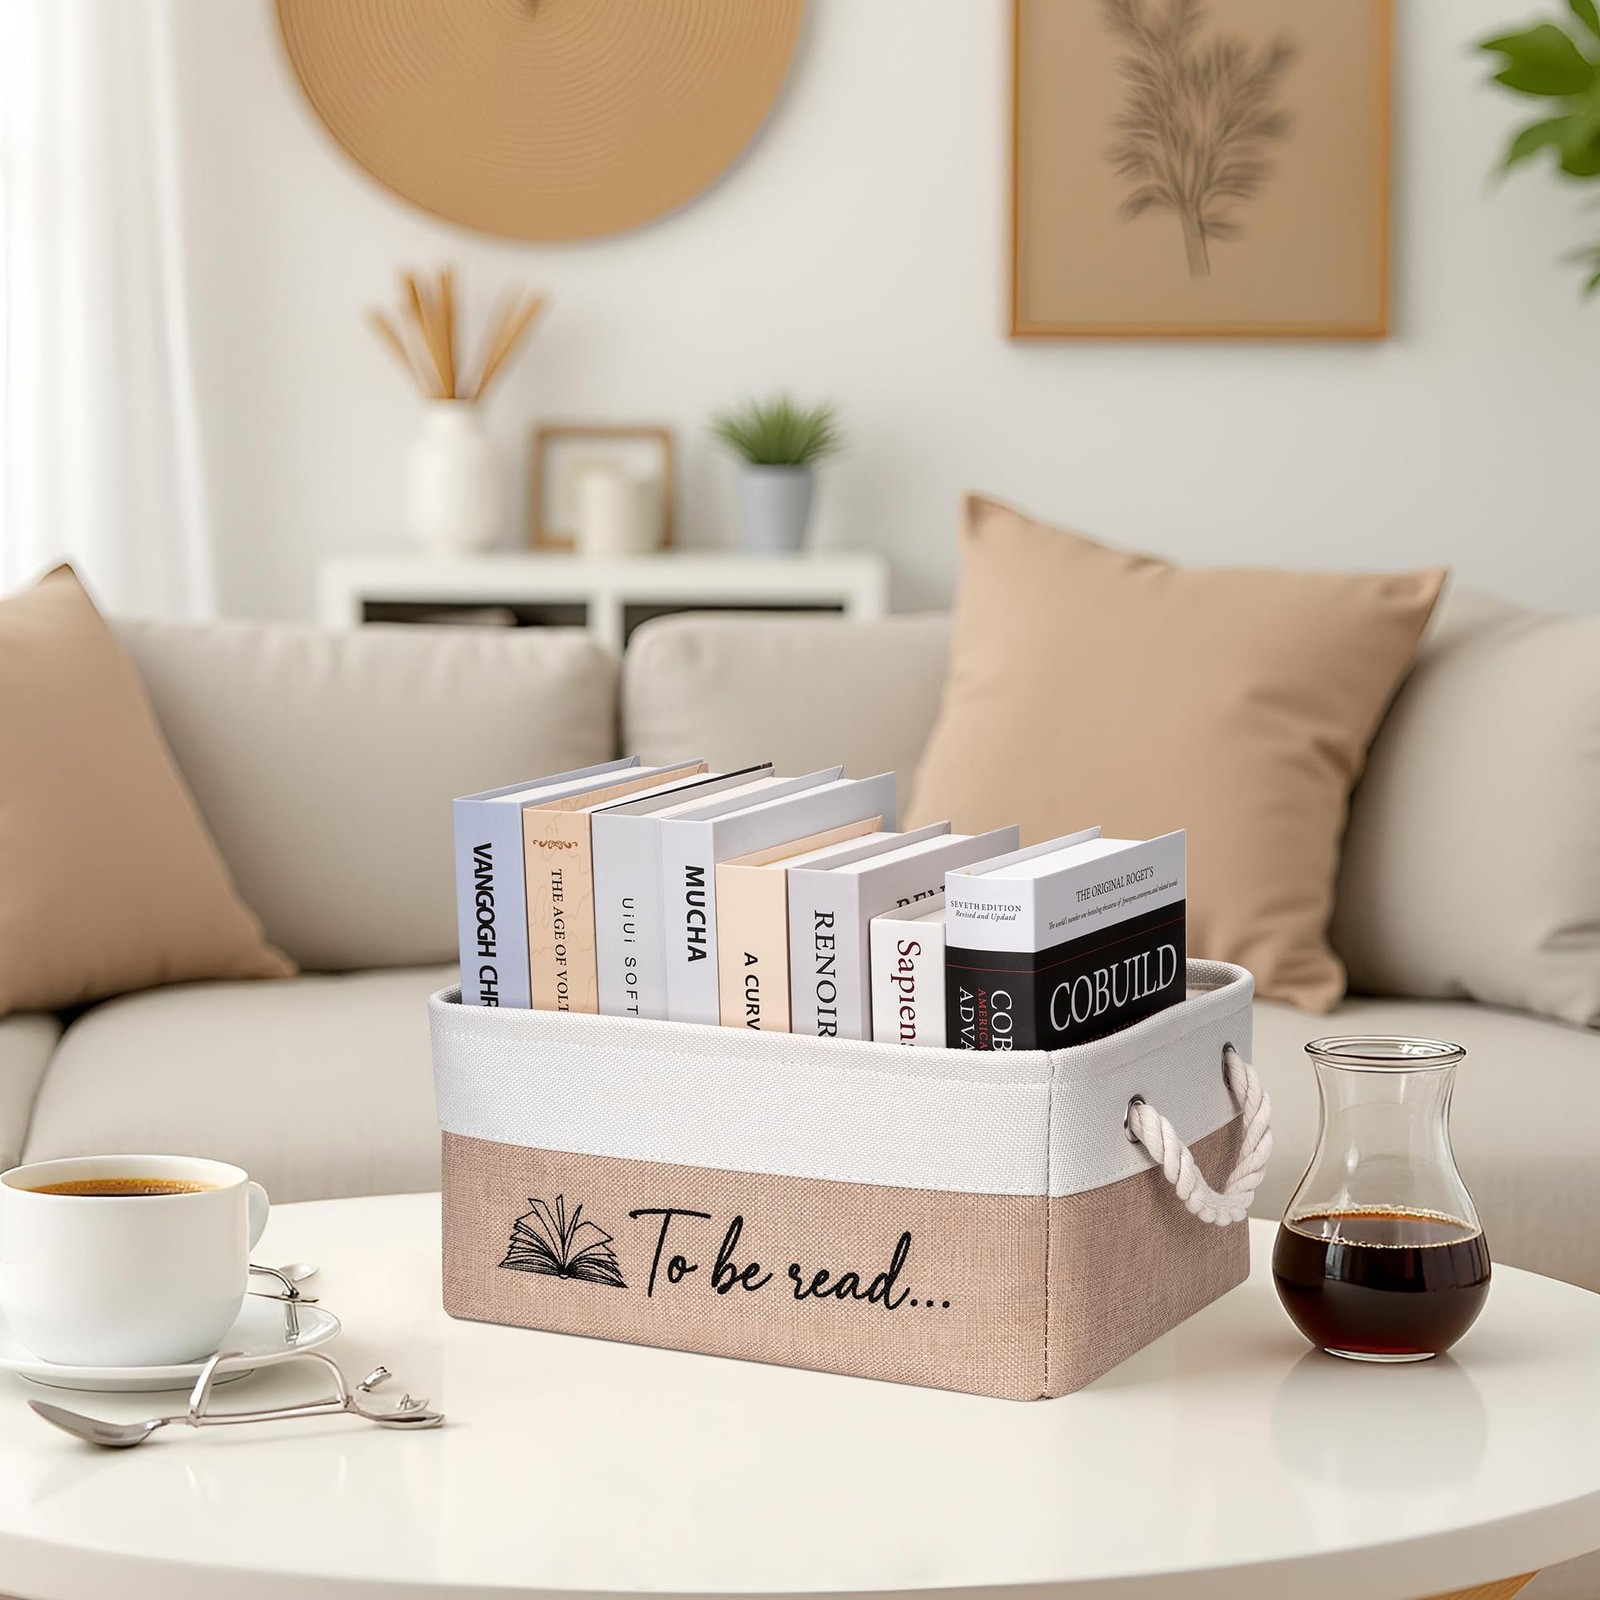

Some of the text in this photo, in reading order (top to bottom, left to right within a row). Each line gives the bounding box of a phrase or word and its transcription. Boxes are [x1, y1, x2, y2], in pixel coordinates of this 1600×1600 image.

[473, 842, 497, 958] VANGOGH
[551, 868, 564, 903] THE
[685, 865, 707, 963] MUCHA
[955, 909, 976, 919] Revised
[976, 912, 990, 920] and
[981, 903, 1022, 912] EDITION
[1075, 889, 1091, 903] THE
[1091, 876, 1126, 898] ORIGINAL
[1126, 866, 1154, 886] ROGET'S
[552, 906, 566, 941] AGE
[554, 943, 568, 967] OF
[621, 897, 640, 1015] UiUi SOFT
[814, 909, 838, 1037] RENOIR
[1050, 943, 1178, 1032] COBUILD
[744, 951, 761, 1031] A CURV
[890, 939, 922, 1047] Sapien
[959, 986, 976, 1050] ADVA
[978, 988, 989, 1049] AMERICA
[990, 989, 1013, 1051] COB
[629, 1208, 951, 1311] To be read...
